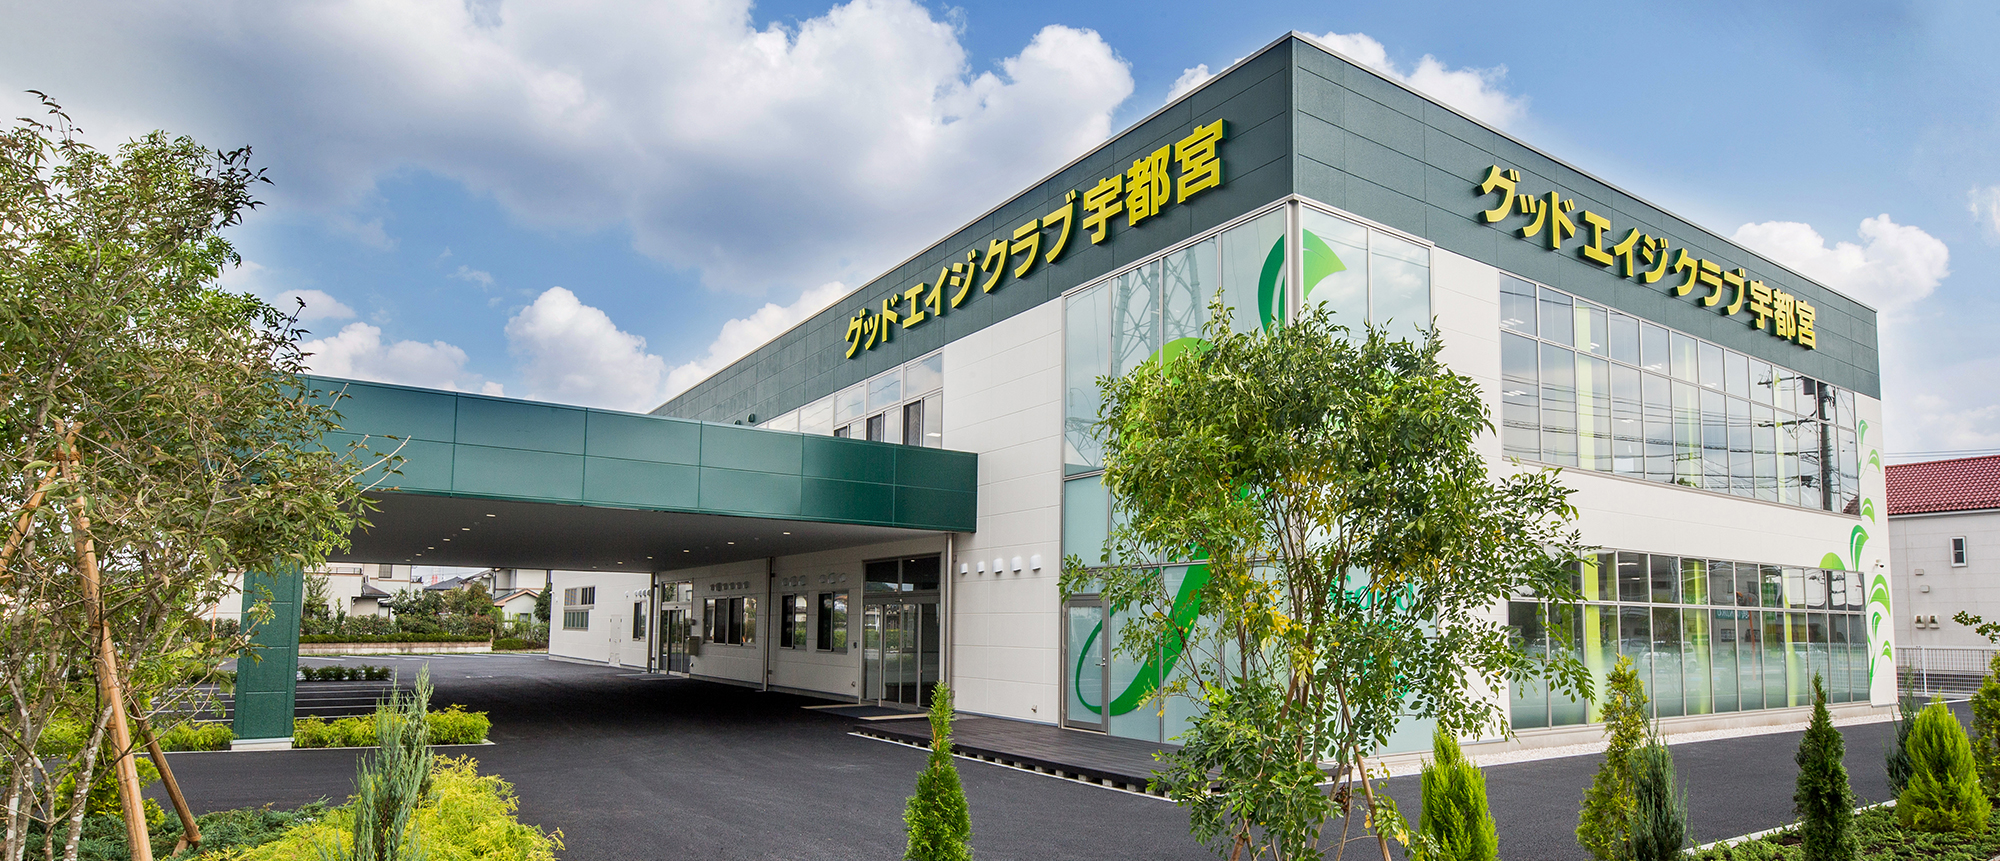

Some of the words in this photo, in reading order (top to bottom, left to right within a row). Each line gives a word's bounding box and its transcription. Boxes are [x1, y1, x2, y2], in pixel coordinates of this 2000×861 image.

[844, 117, 1227, 359] グッドエイジクラブ宇都宮
[1480, 164, 1816, 350] グッドエイジクラブ宇都宮
